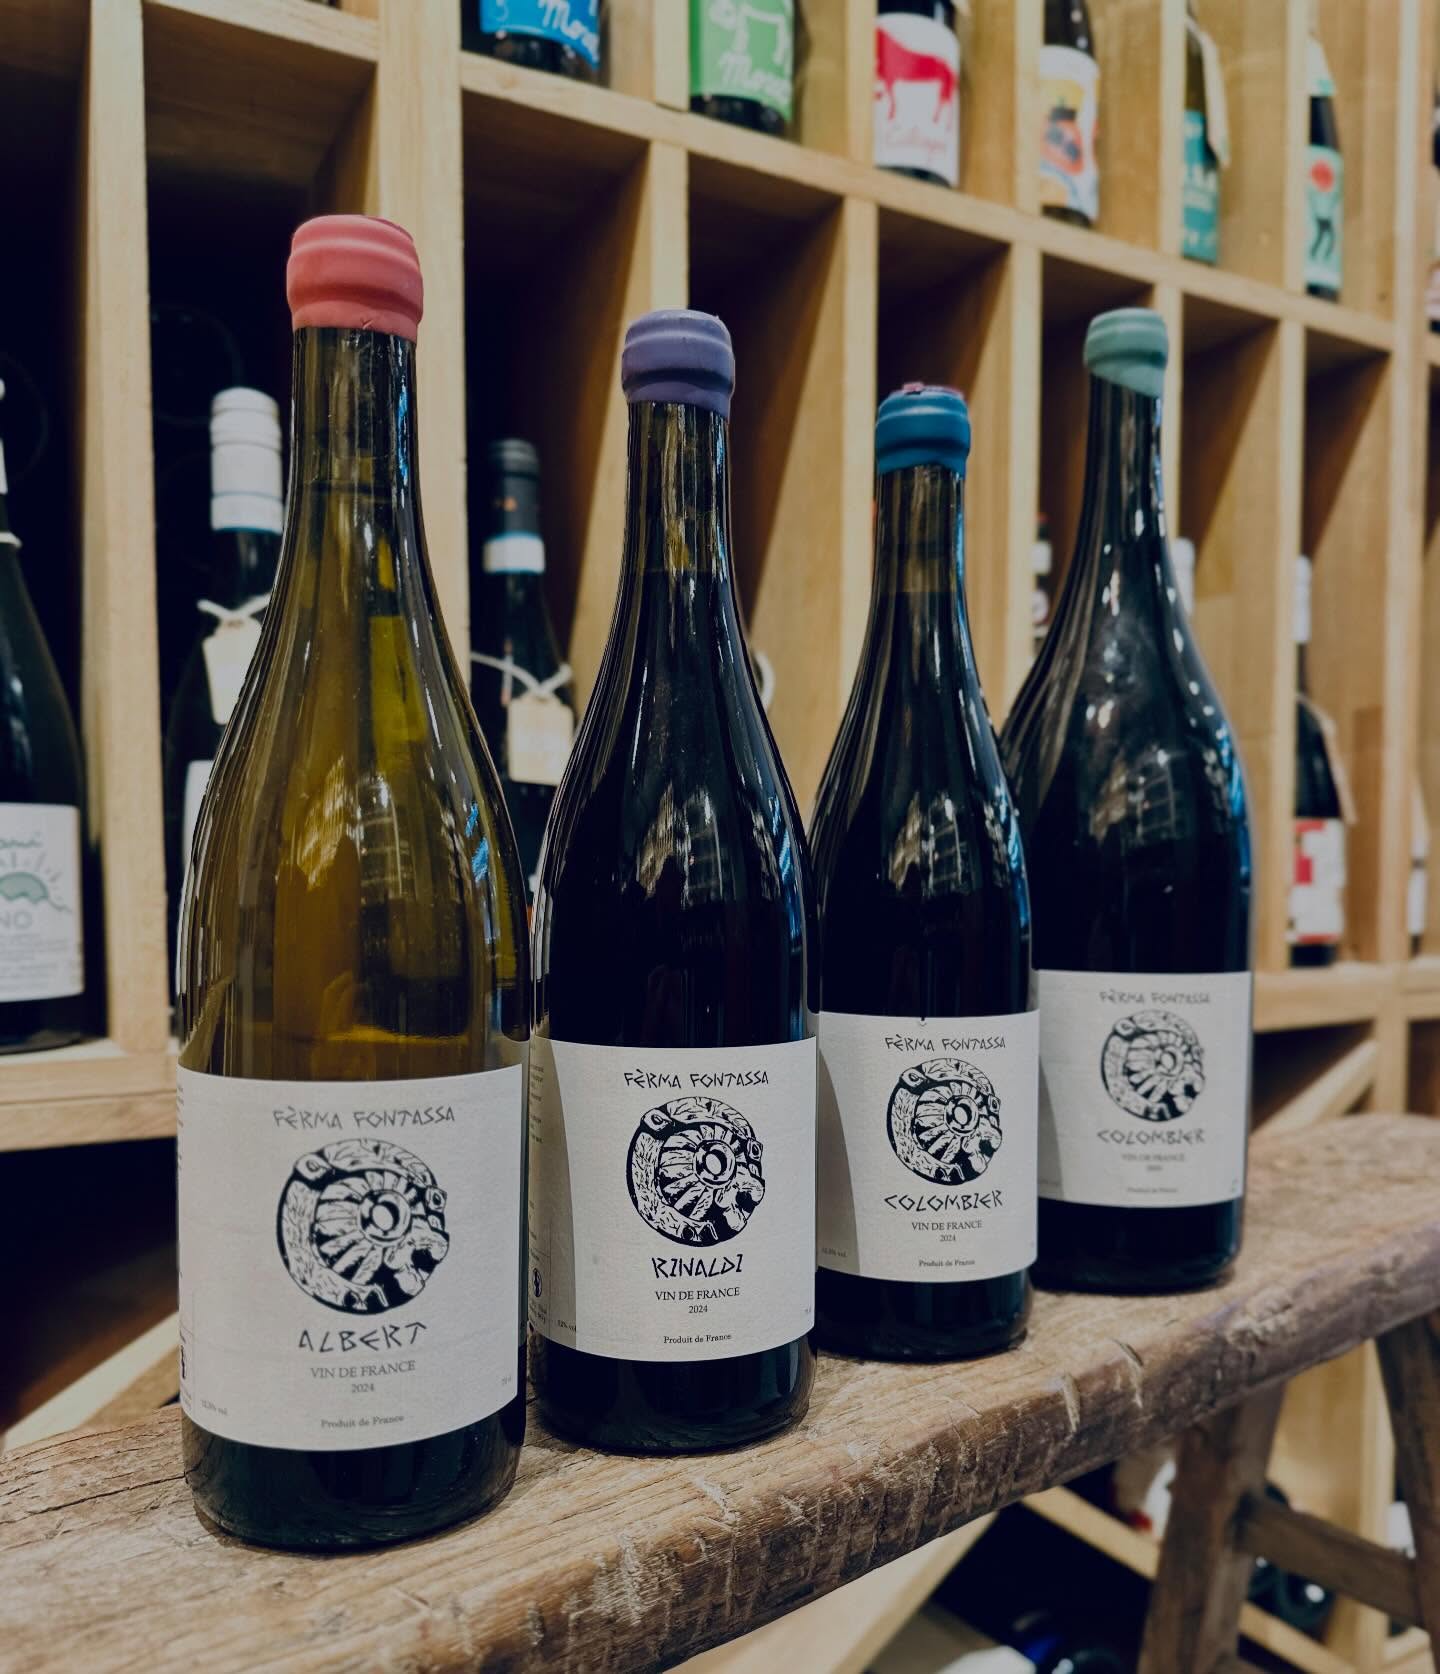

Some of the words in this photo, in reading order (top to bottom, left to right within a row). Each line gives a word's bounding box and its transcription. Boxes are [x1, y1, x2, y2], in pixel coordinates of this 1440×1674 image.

[886, 1034, 934, 1051] FÈRMA
[942, 1037, 1005, 1050] FONTASSA
[624, 1069, 681, 1088] FÈRMA
[690, 1070, 768, 1088] FONTASSA
[273, 1106, 343, 1129] FÈRMA
[354, 1106, 455, 1128] FONTASSA
[884, 1190, 1002, 1212] COLOMBIER
[912, 1222, 930, 1231] VIN
[931, 1222, 945, 1231] DE
[947, 1220, 982, 1230] FRANCE
[652, 1254, 743, 1279] RINALDI
[655, 1291, 676, 1300] VIN
[678, 1291, 694, 1300] DE
[696, 1287, 740, 1300] FRANCE
[688, 1304, 708, 1314] 2024
[298, 1322, 427, 1353] ALBERT
[663, 1335, 692, 1344] Produit
[706, 1333, 731, 1343] France
[310, 1367, 336, 1379] VIN
[338, 1366, 357, 1378] DE
[359, 1361, 416, 1376] FRANCE
[351, 1383, 375, 1394] 2024
[321, 1419, 356, 1429] Produit
[358, 1418, 370, 1427] de
[372, 1416, 404, 1426] France
